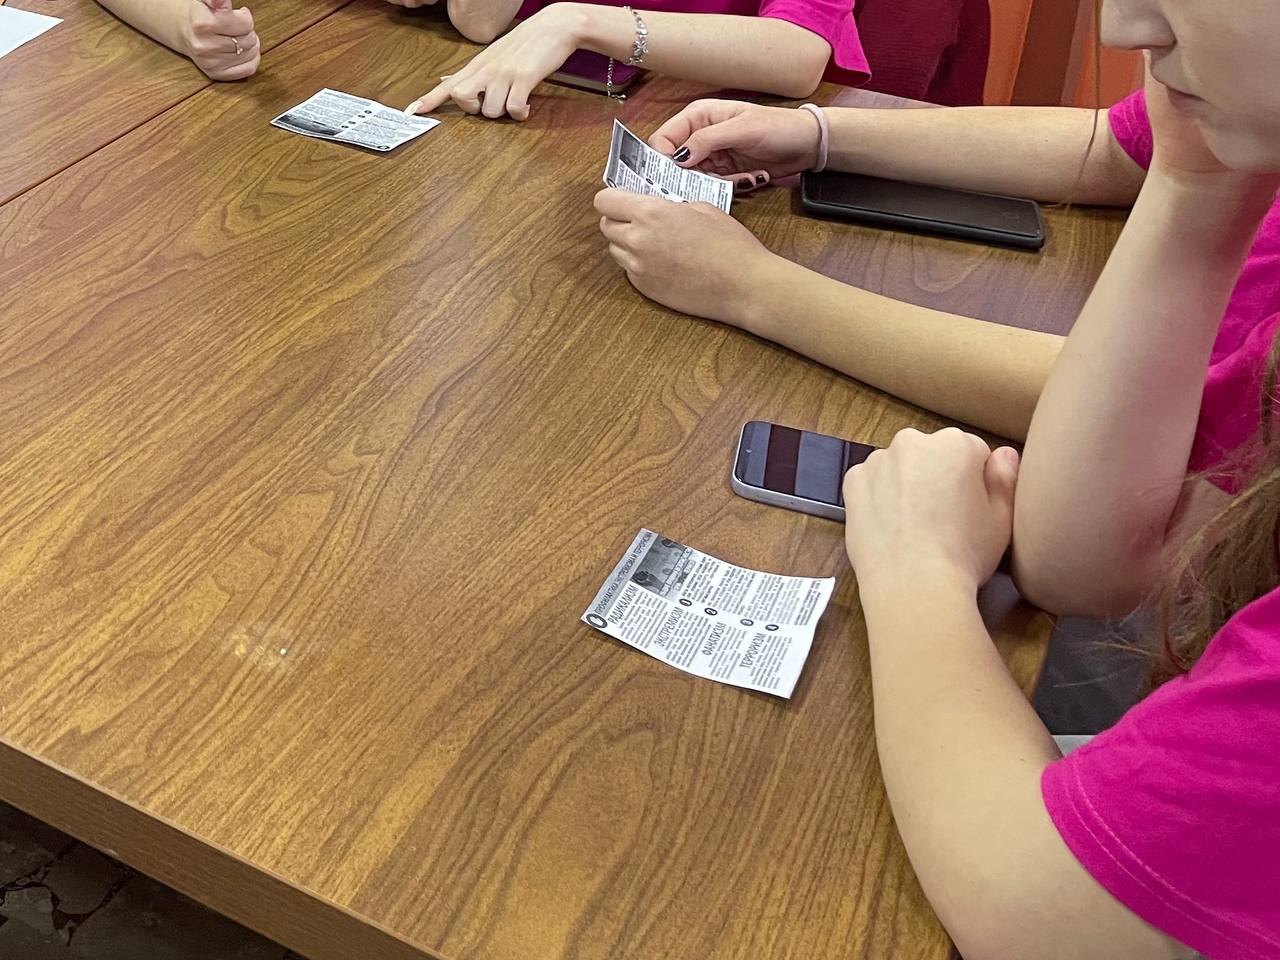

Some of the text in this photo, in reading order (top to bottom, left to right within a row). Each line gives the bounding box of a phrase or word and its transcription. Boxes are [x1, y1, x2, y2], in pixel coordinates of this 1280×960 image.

[607, 585, 640, 624] РАДИКАЛИЗМ
[654, 607, 685, 648] ЭКСТРЕМИЗМ
[702, 622, 727, 656] ФАНАТИЗМ
[740, 632, 767, 669] ТЕРРОРИЗМ
